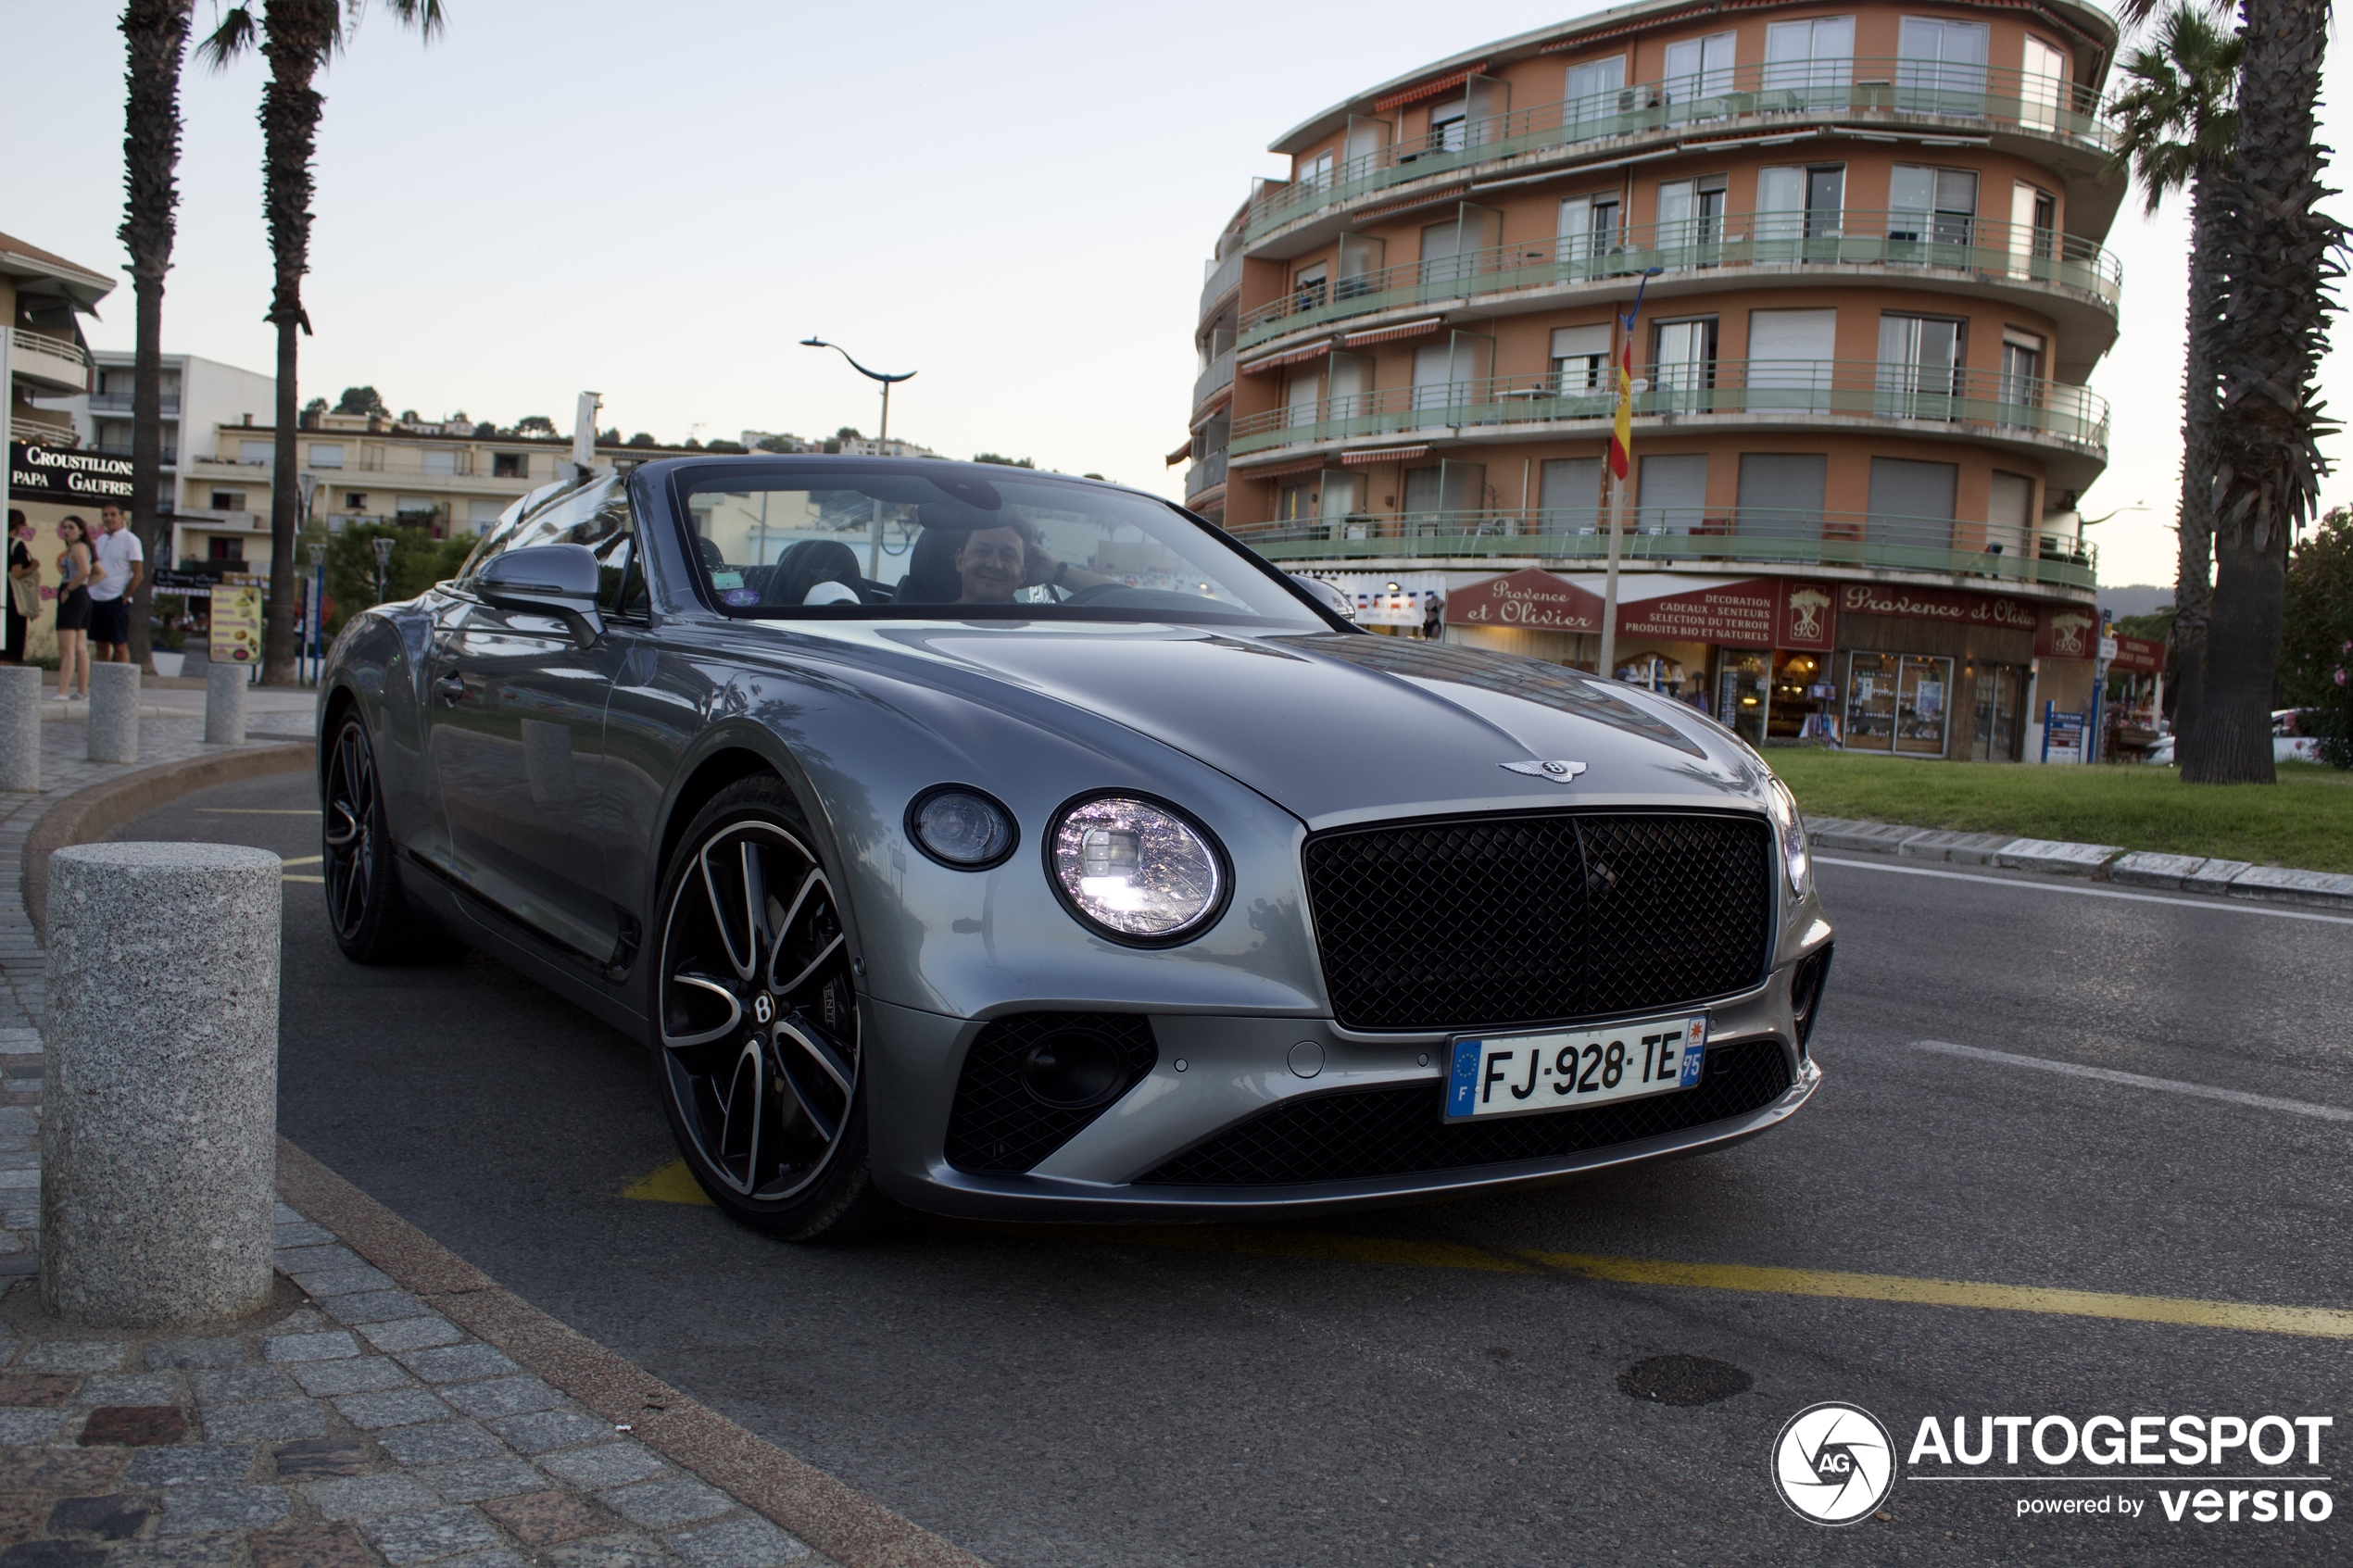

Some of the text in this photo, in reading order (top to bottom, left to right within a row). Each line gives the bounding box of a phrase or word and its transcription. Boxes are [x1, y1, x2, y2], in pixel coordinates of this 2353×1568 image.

[12, 470, 49, 487] PAPA
[1492, 580, 1570, 602] Provence
[1705, 594, 1770, 608] DECORATION
[1467, 599, 1592, 627] et Olivier
[1660, 602, 1708, 614] CADEAUX
[1718, 607, 1770, 619] SENTEURS
[1846, 585, 1965, 617] Provence
[1970, 605, 1991, 621] et
[1626, 621, 1769, 642] PRODUITS BIO ET NATURELS
[1650, 612, 1769, 630] SELECTION DU TERROIR
[1459, 1087, 1467, 1101] F
[1682, 1053, 1701, 1078] 75
